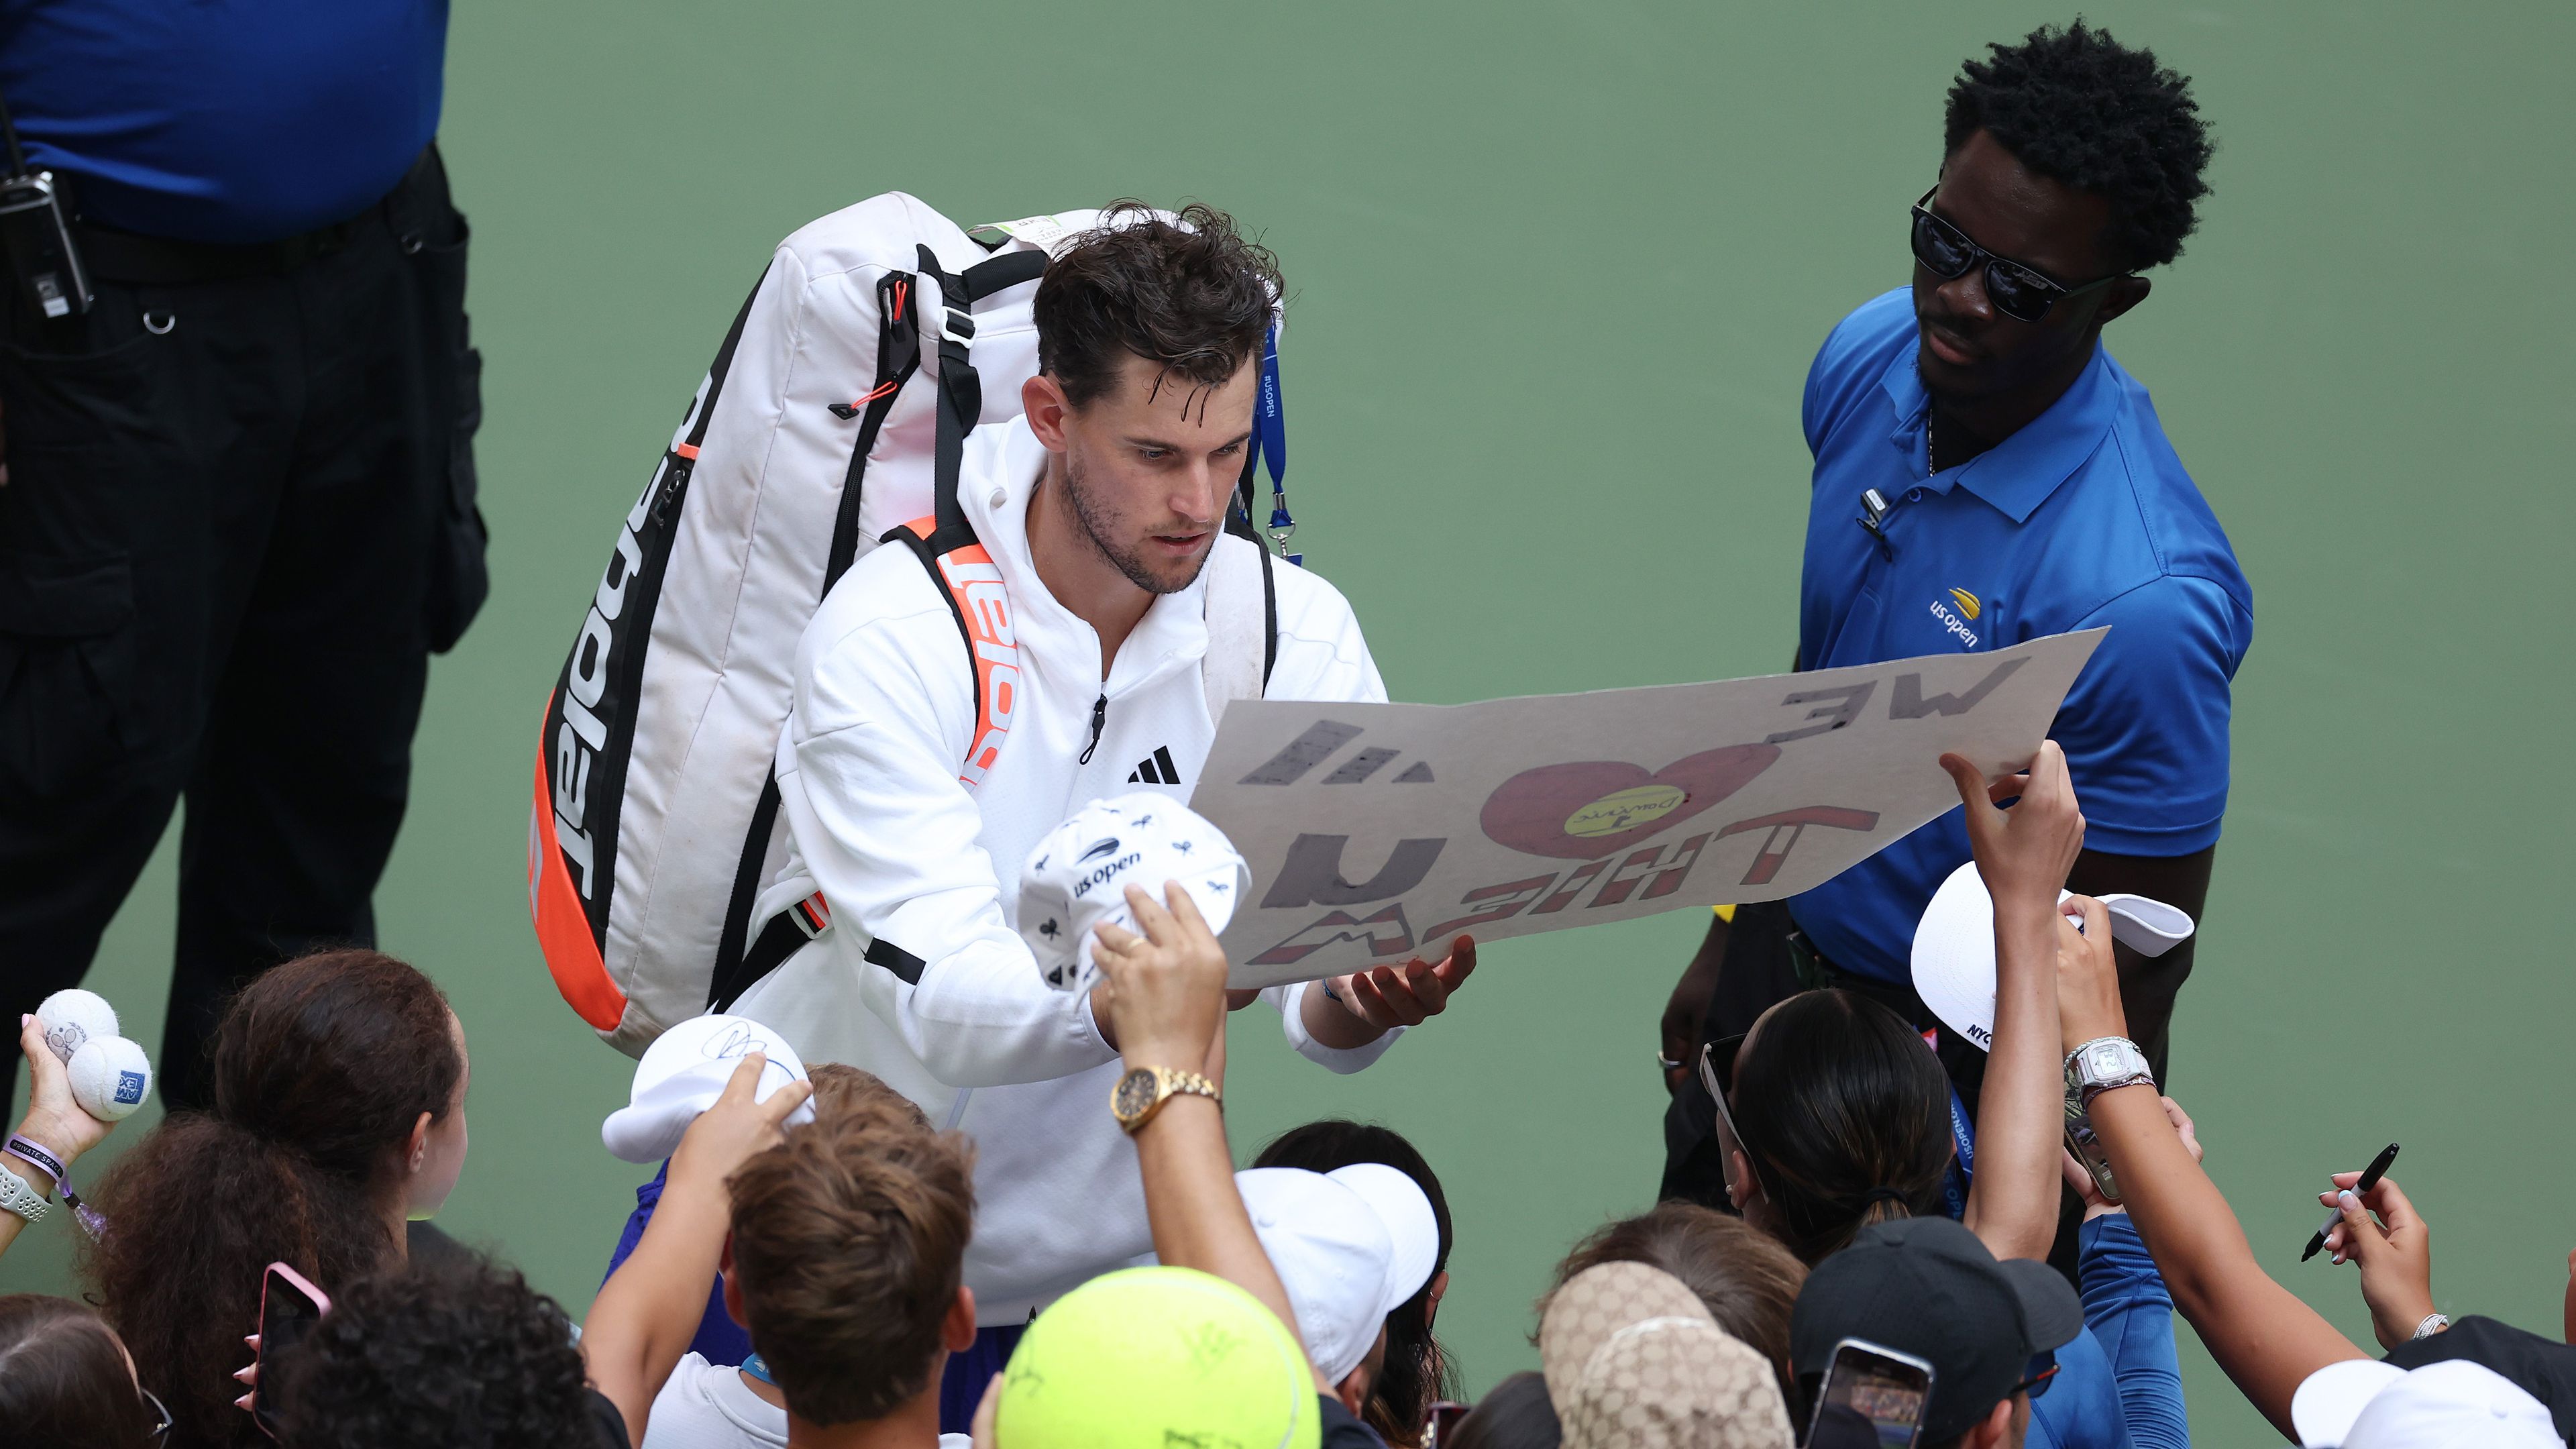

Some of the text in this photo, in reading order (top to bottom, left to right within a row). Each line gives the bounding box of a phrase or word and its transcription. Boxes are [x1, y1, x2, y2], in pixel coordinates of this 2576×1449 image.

[1264, 375, 1275, 418] #USOPEN
[1967, 1024, 1992, 1044] NYC
[118, 1075, 138, 1089] EX
[116, 1087, 138, 1099] AM
[13, 1142, 62, 1173] PRIVATE SPACE
